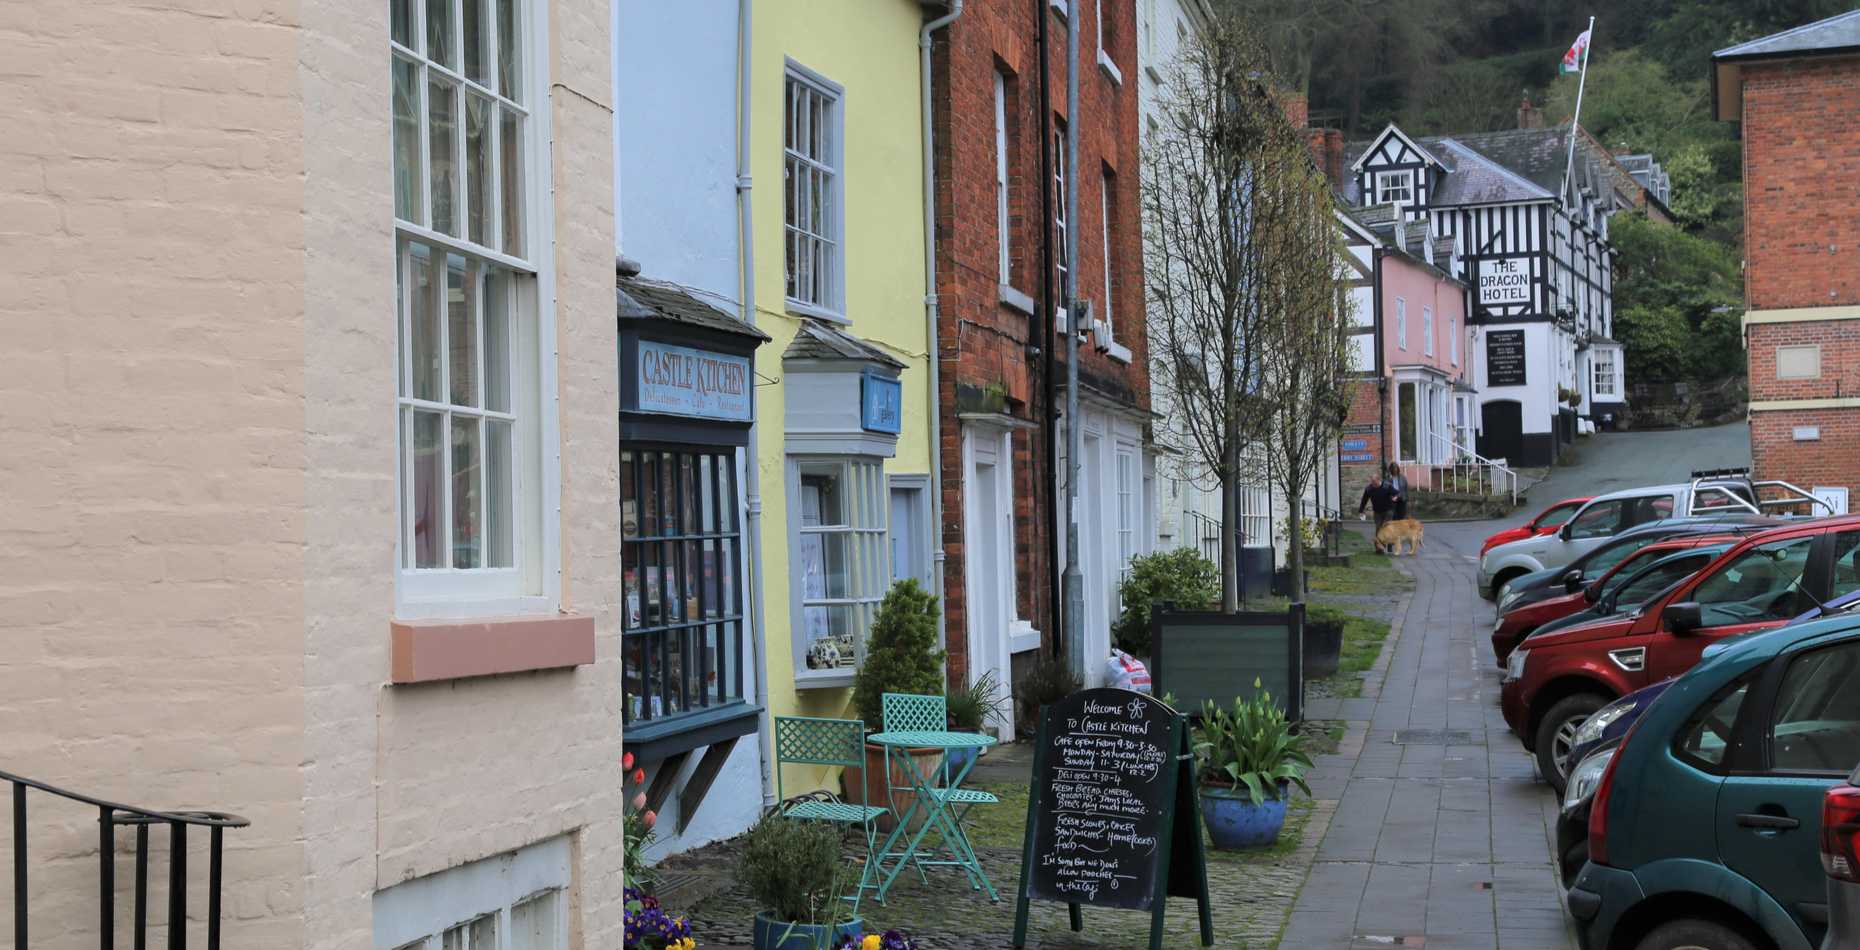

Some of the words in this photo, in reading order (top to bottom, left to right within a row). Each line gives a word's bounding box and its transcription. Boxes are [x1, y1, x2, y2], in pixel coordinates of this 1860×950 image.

[1492, 261, 1517, 273] THE
[1481, 274, 1528, 287] DRAGON
[1484, 288, 1526, 300] HOTEL
[643, 349, 693, 389] CASTLE
[696, 357, 746, 397] KITCHEN
[645, 387, 681, 406] Delicatessen
[718, 396, 745, 412] Restaurant
[1067, 719, 1077, 729] TO
[1081, 716, 1107, 734] CASTLE
[1054, 736, 1072, 746] CAFE
[1075, 738, 1094, 748] OPEN
[1064, 757, 1095, 770] SUNDAY
[1074, 773, 1090, 782] OPEN
[1051, 783, 1073, 792] FRESH
[1122, 798, 1143, 806] LOCAL
[1057, 813, 1079, 826] FRESH
[1110, 821, 1135, 834] CAKES
